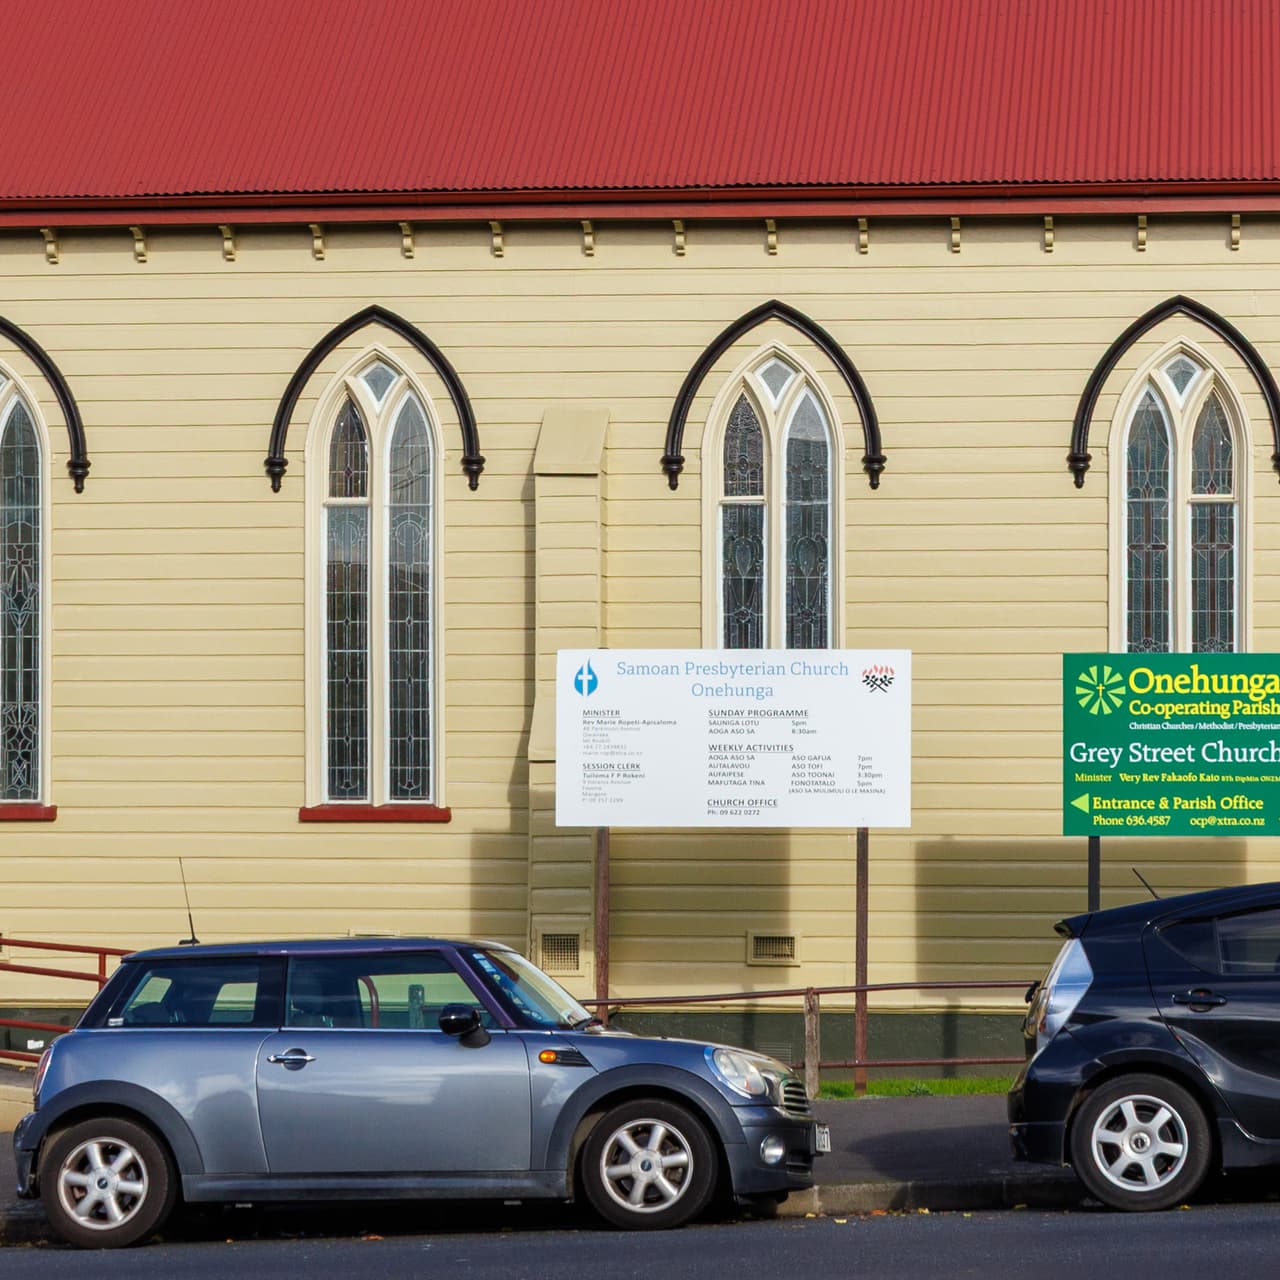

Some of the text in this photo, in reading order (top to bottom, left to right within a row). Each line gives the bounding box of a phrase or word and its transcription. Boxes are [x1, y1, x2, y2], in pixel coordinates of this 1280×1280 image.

[616, 662, 848, 679] Samoan Presbyterian Church
[1128, 664, 1280, 701] Onehunga
[691, 682, 774, 700] Onehunga
[582, 709, 621, 717] MINISTER
[708, 709, 809, 717] SUNDAY PROGRAMME
[1128, 700, 1230, 720] Co-operating
[1128, 722, 1160, 730] Christian
[1162, 722, 1194, 730] Churches
[1199, 722, 1234, 730] Methodist
[708, 744, 794, 752] WEEKLY ACTIVITIES
[1070, 742, 1123, 768] Grey
[1129, 742, 1195, 762] Street
[582, 762, 641, 770] SESSION CLERK
[1074, 773, 1112, 782] Minister
[1119, 774, 1140, 784] Very
[1142, 774, 1159, 782] Rev
[1161, 772, 1198, 782] Fakaofo
[1199, 773, 1220, 782] Kaio
[707, 799, 778, 807] CHURCH OFFICE
[1092, 794, 1264, 810] Entrance & Parish Office
[1092, 815, 1124, 826] Phone
[1126, 815, 1171, 826] 636.4587
[1190, 816, 1265, 828] ocp@xtra.co.nz
